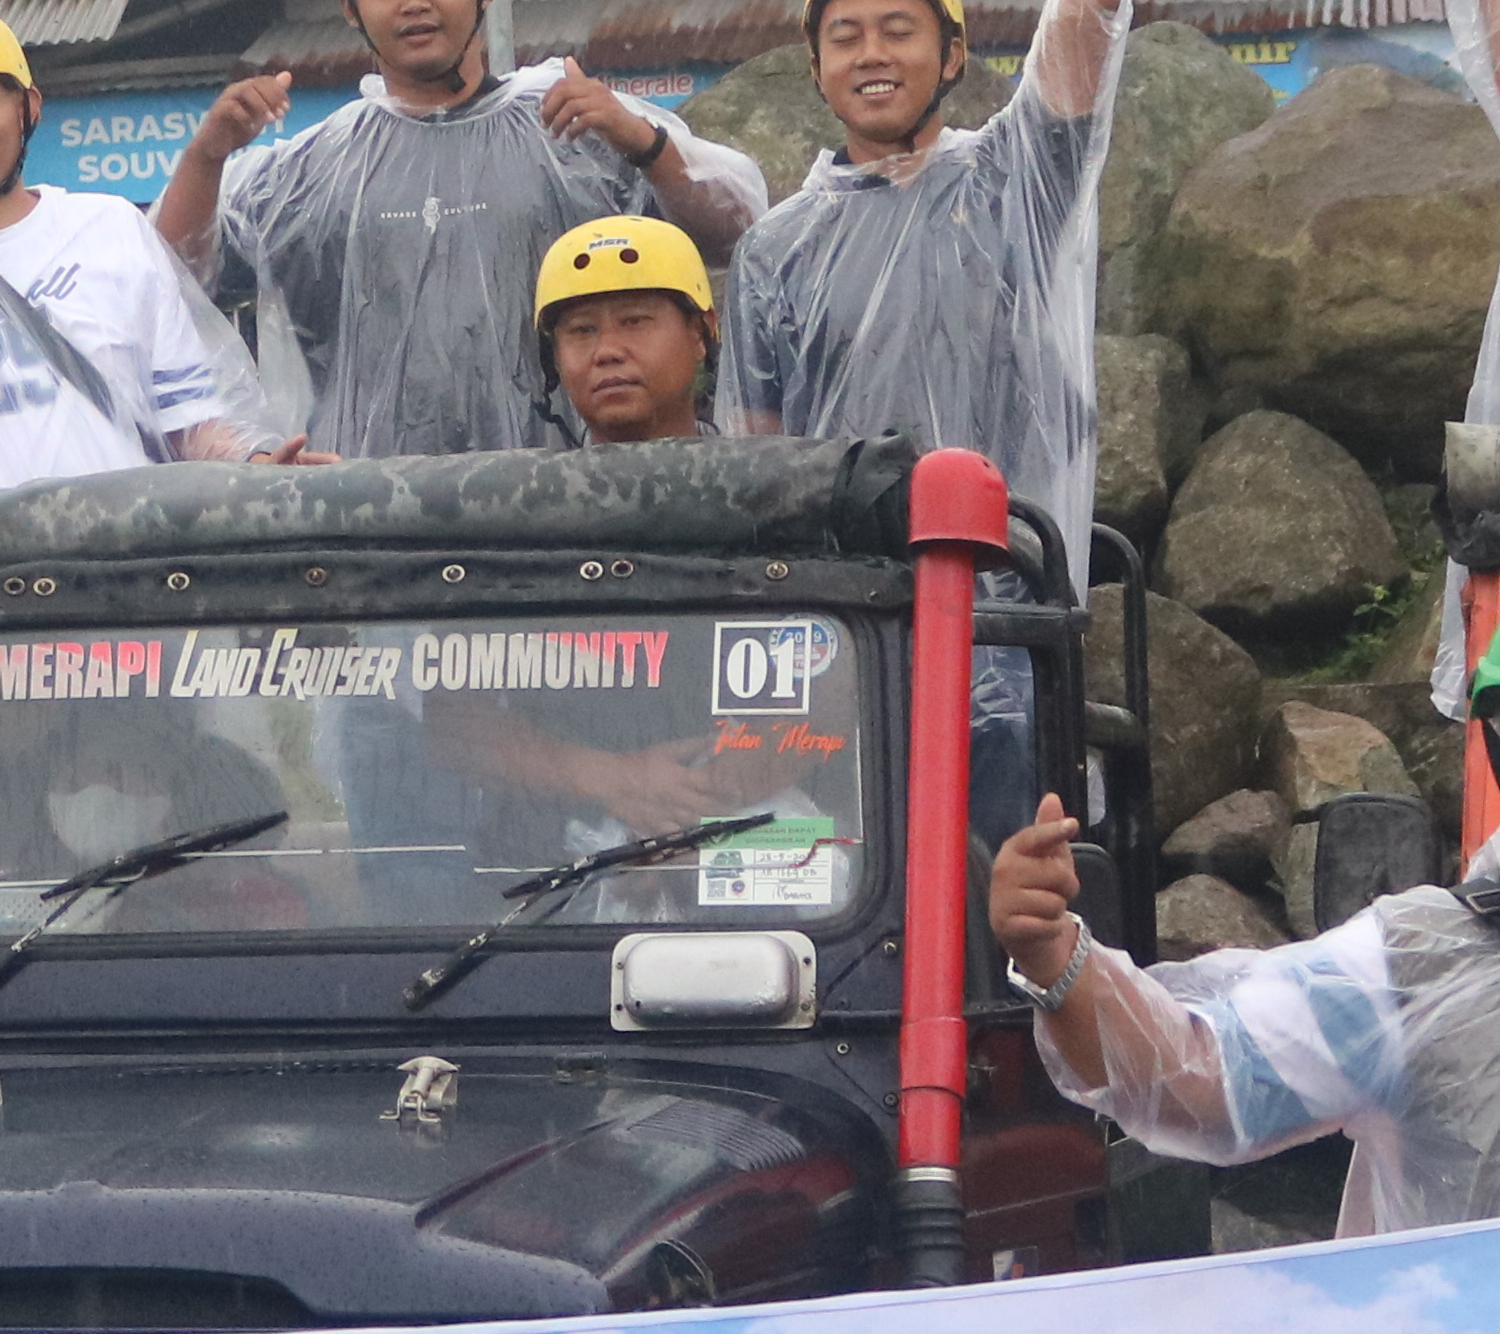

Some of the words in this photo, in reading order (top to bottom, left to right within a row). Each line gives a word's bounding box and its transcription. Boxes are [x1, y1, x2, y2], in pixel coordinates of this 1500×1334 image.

[169, 629, 265, 699] LAND
[271, 627, 402, 701] CRUISER
[412, 630, 668, 693] COMMUNITY
[727, 638, 796, 699] 01
